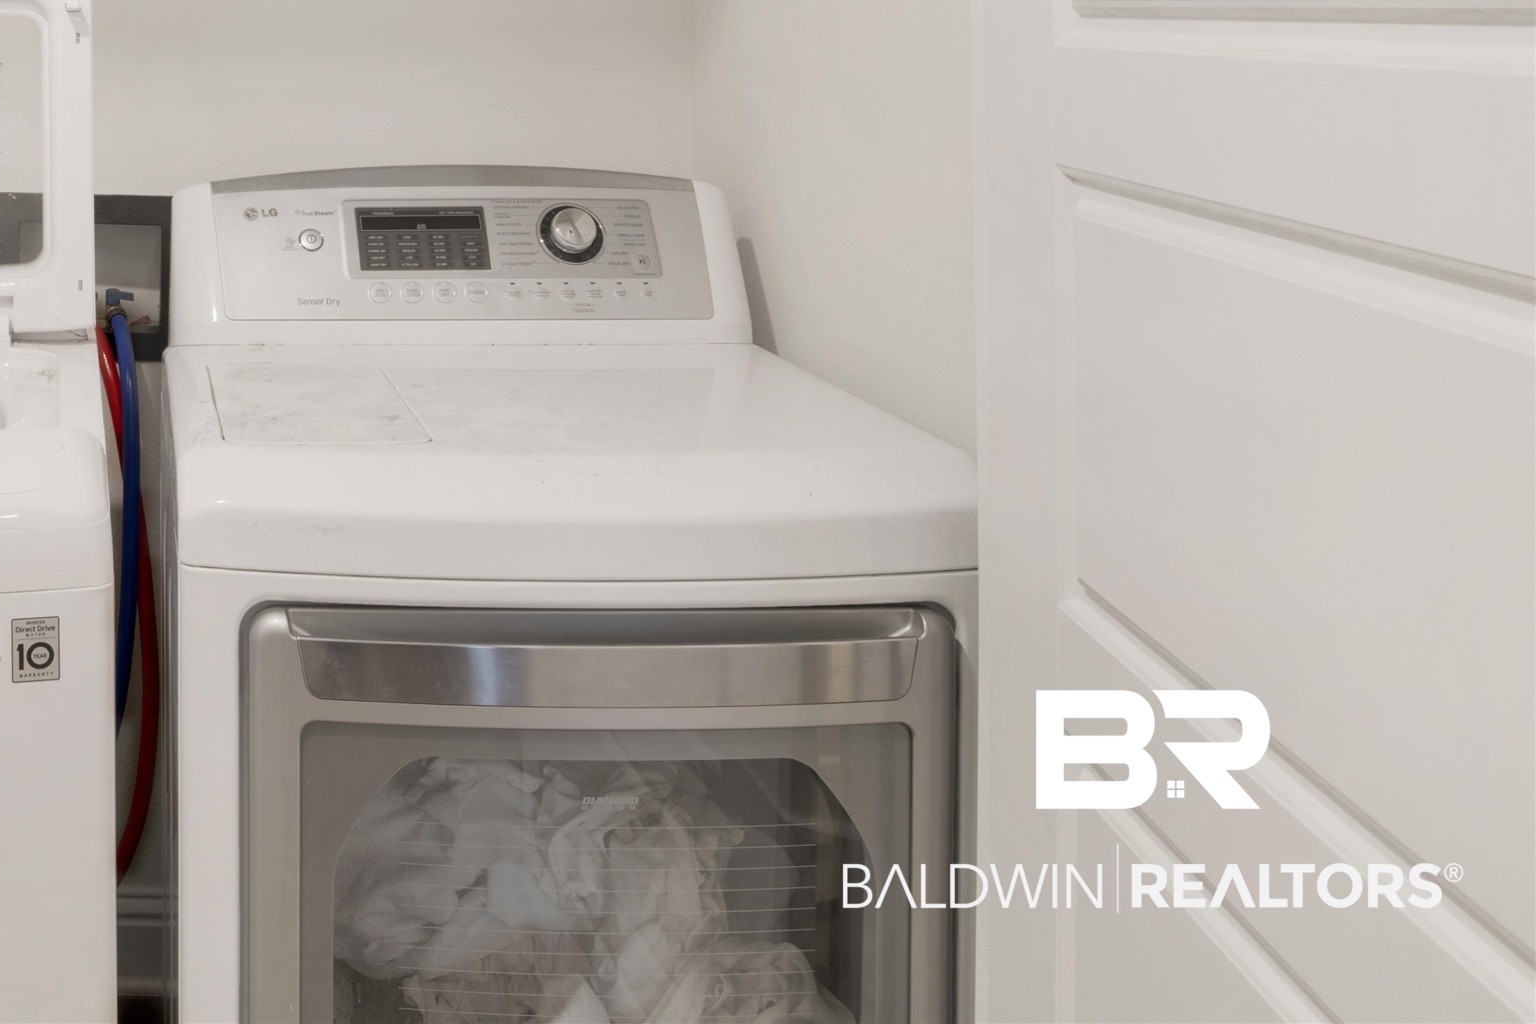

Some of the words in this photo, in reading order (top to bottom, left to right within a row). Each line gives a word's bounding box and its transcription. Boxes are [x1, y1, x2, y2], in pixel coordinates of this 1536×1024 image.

[261, 208, 278, 217] LG
[297, 298, 324, 306] Sensor
[326, 298, 340, 307] Dry
[16, 642, 55, 670] 10
